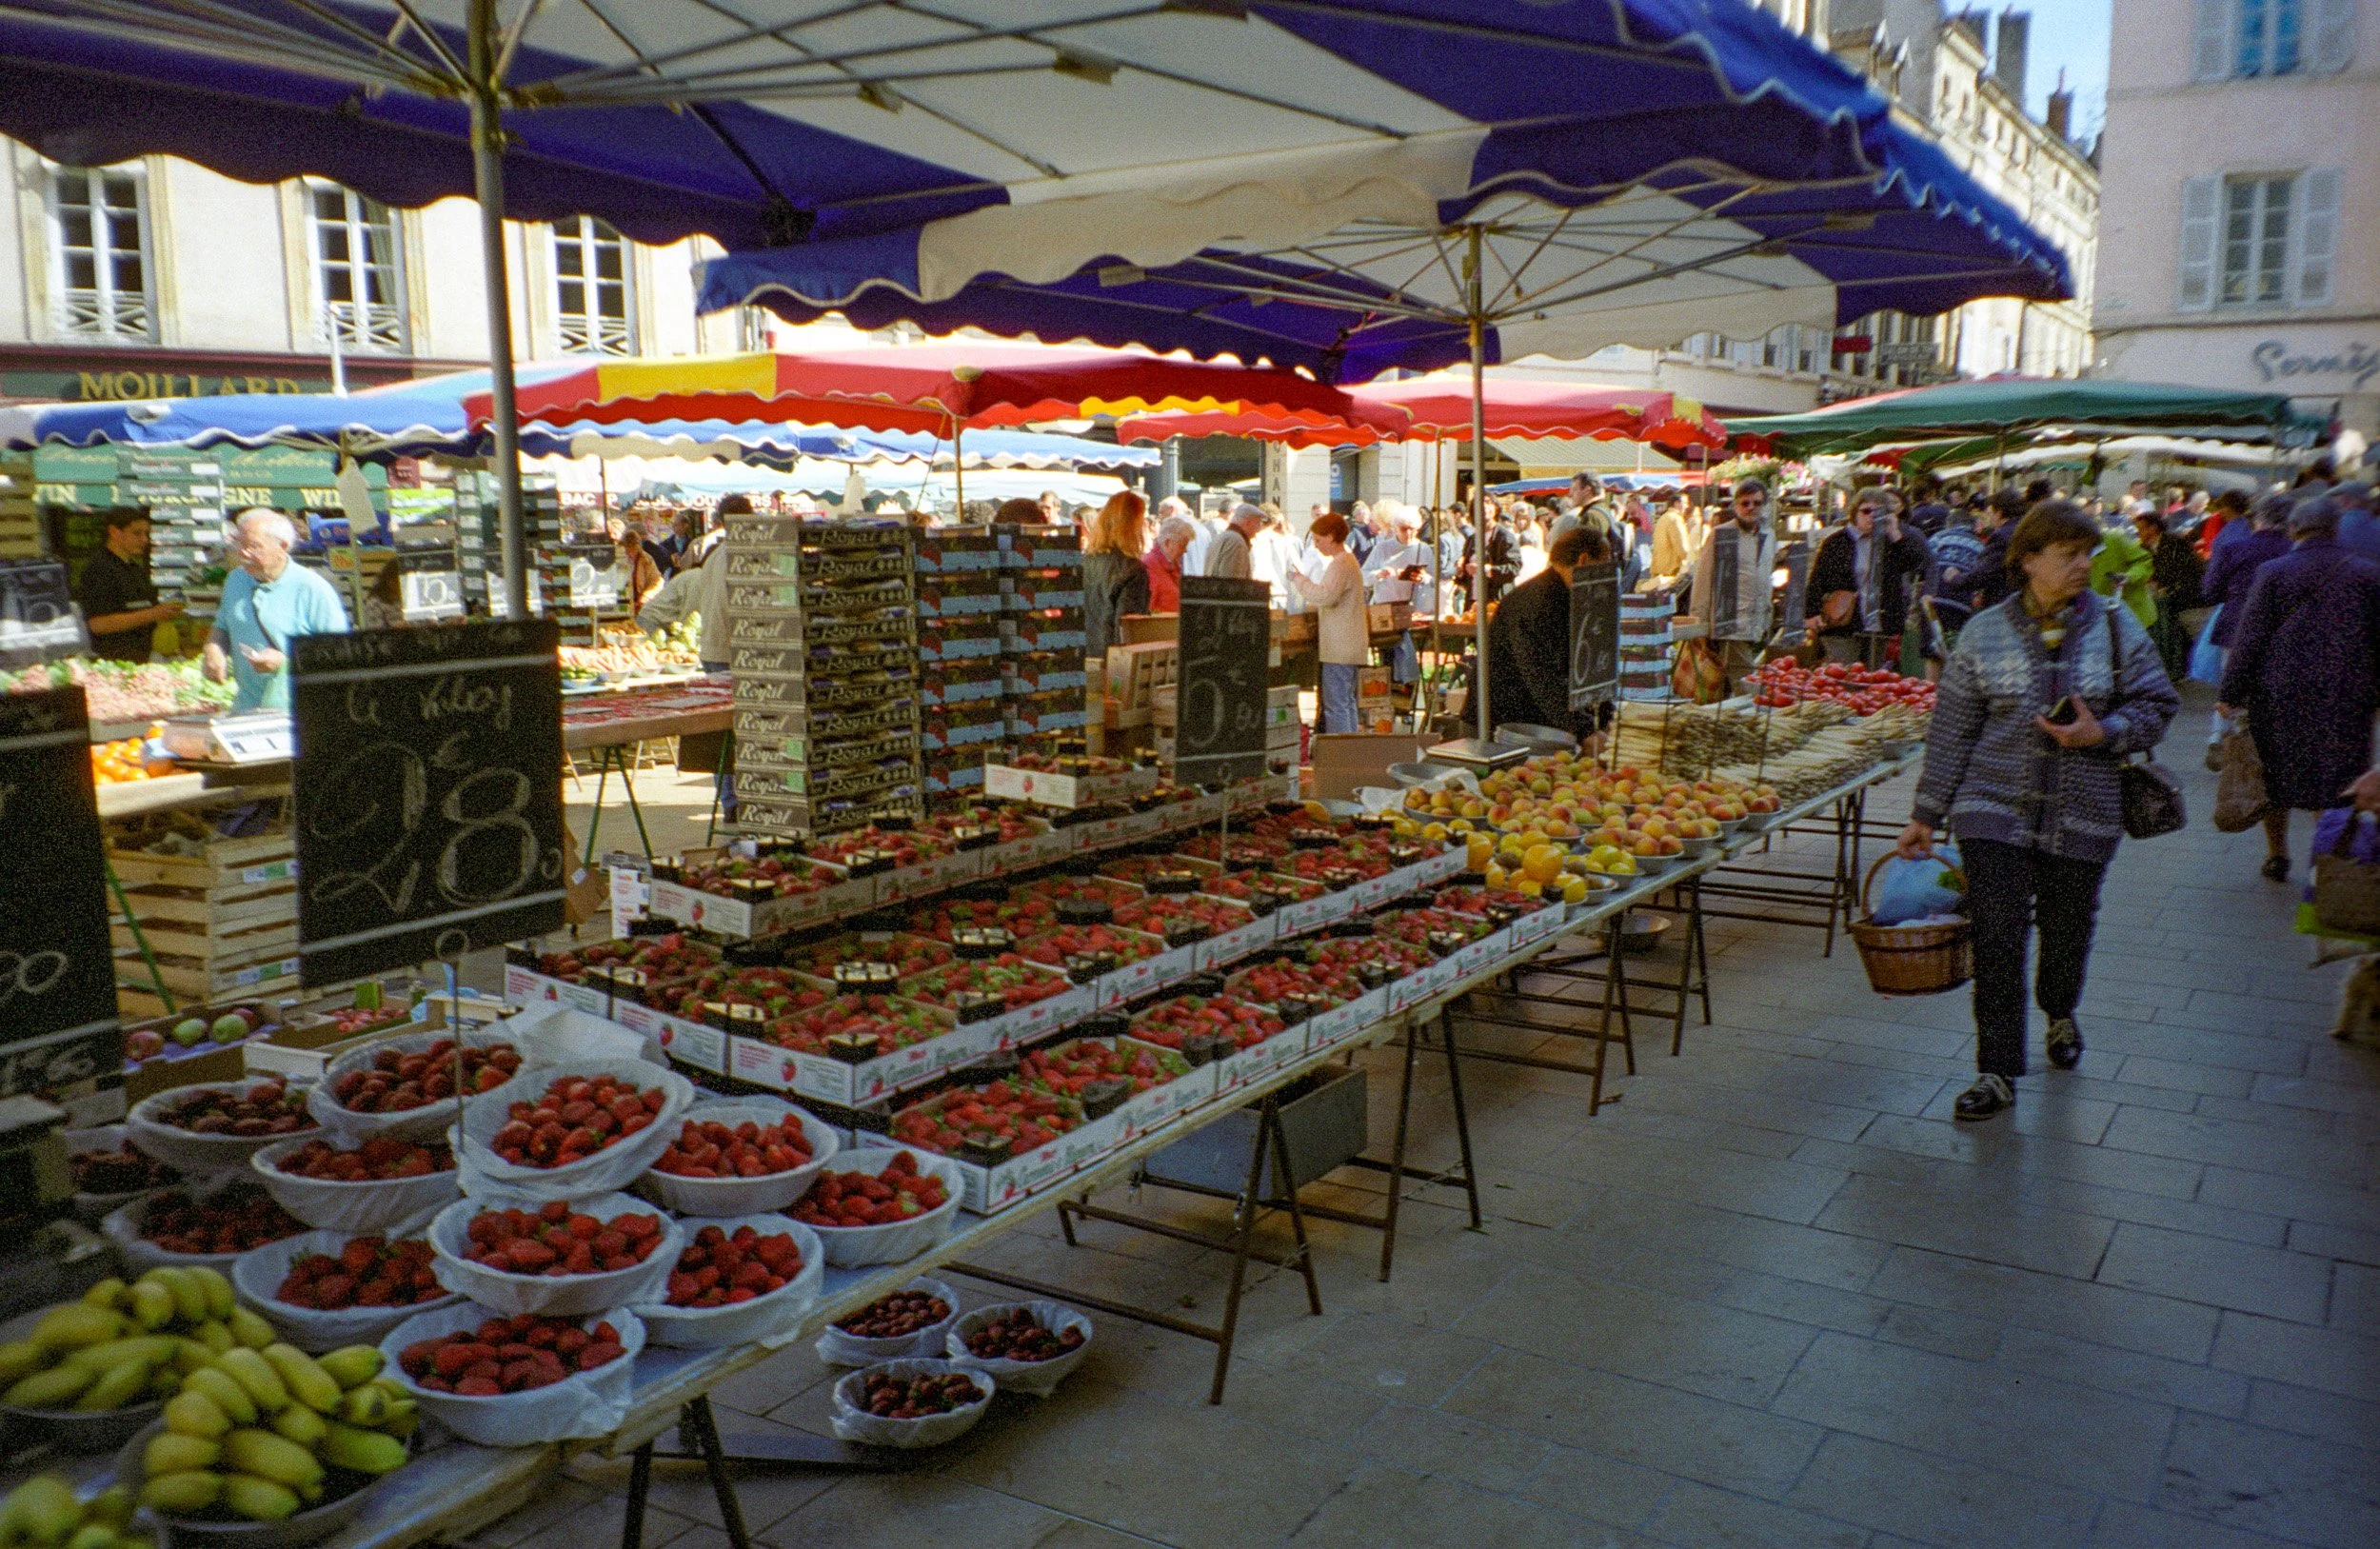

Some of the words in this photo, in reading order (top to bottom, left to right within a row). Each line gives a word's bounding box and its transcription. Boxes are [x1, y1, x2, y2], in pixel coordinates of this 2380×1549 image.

[77, 370, 301, 400] MOILLARD
[730, 521, 779, 544] Royal
[730, 554, 772, 577] Roya
[730, 586, 772, 610] Roya
[733, 619, 784, 642] Royal
[735, 649, 786, 670] Royal
[737, 680, 786, 702] Royal
[738, 712, 790, 734] Royal
[738, 773, 783, 795] Roya
[742, 804, 793, 827] Royal
